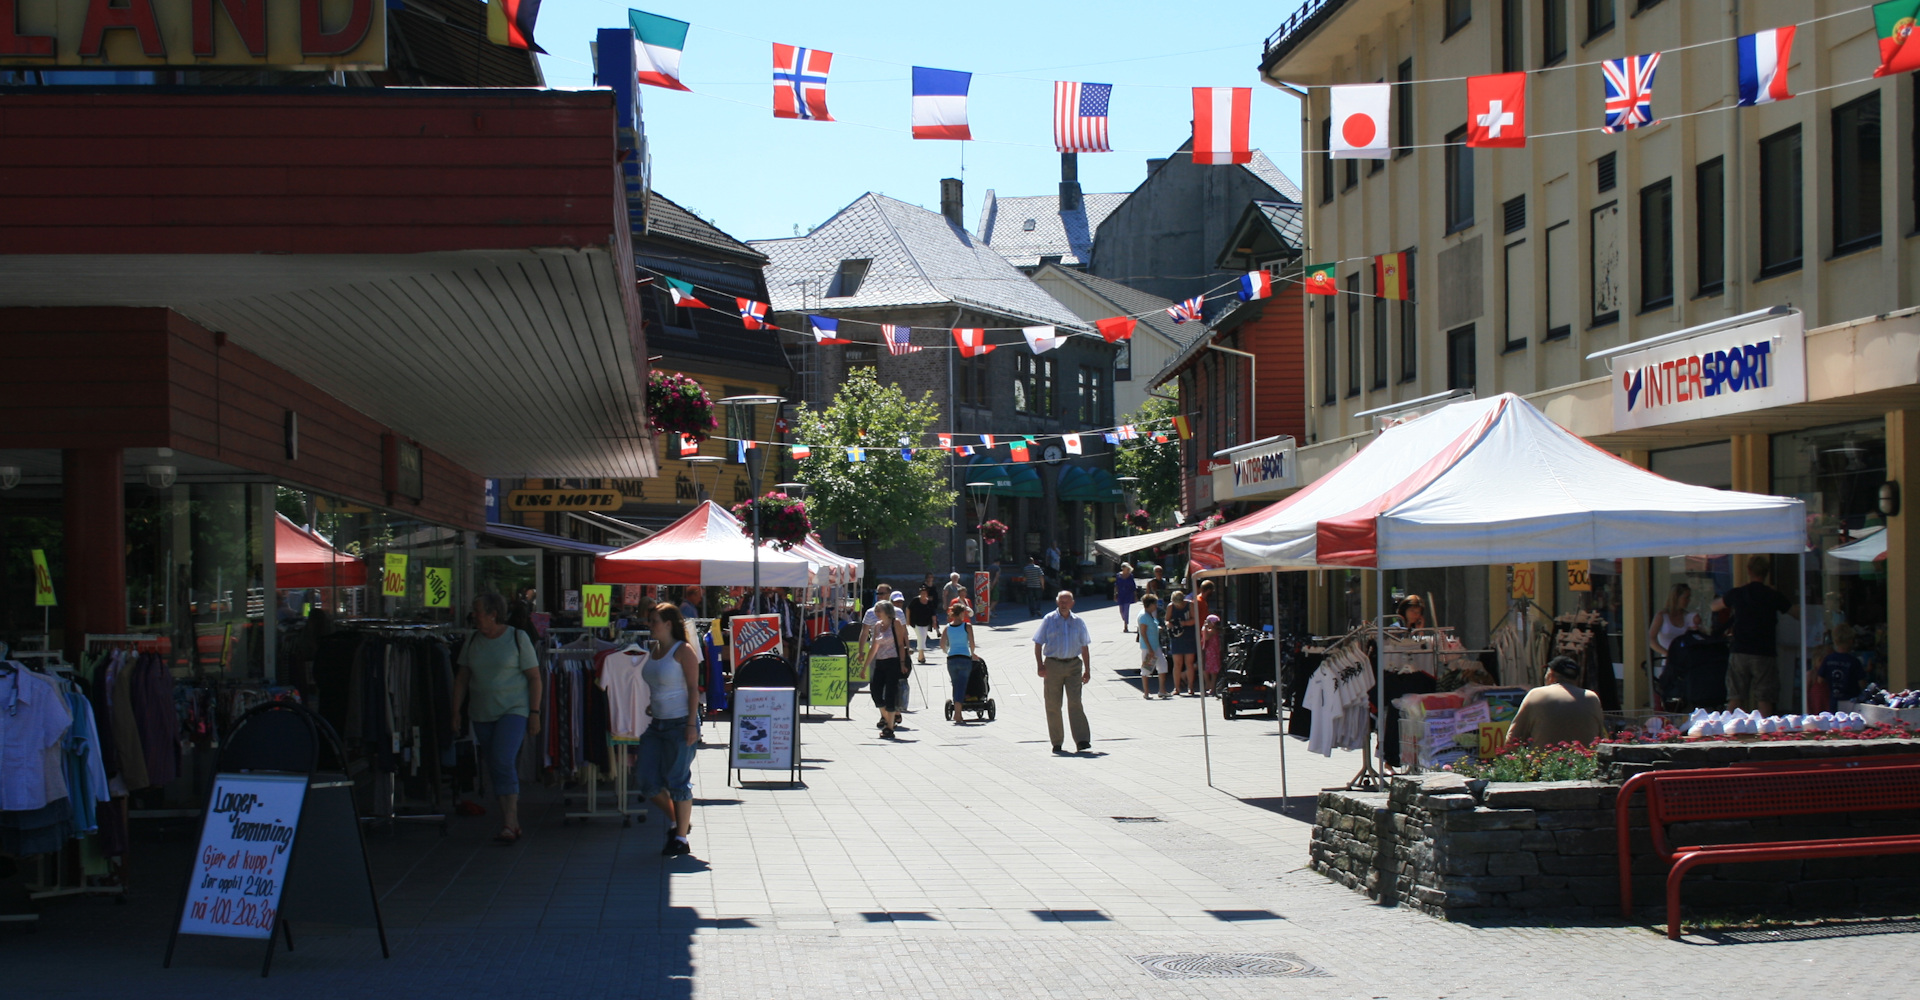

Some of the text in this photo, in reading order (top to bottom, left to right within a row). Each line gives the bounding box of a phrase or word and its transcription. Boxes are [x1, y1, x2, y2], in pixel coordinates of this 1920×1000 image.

[1644, 341, 1770, 409] INTERSPORT
[1241, 452, 1284, 486] INTERSPORT
[515, 494, 614, 506] UNG MOTE
[739, 627, 778, 660] ZORBA
[212, 786, 264, 822] Lager-
[231, 818, 293, 854] tømming
[202, 845, 226, 871] Gjør
[227, 850, 241, 869] et
